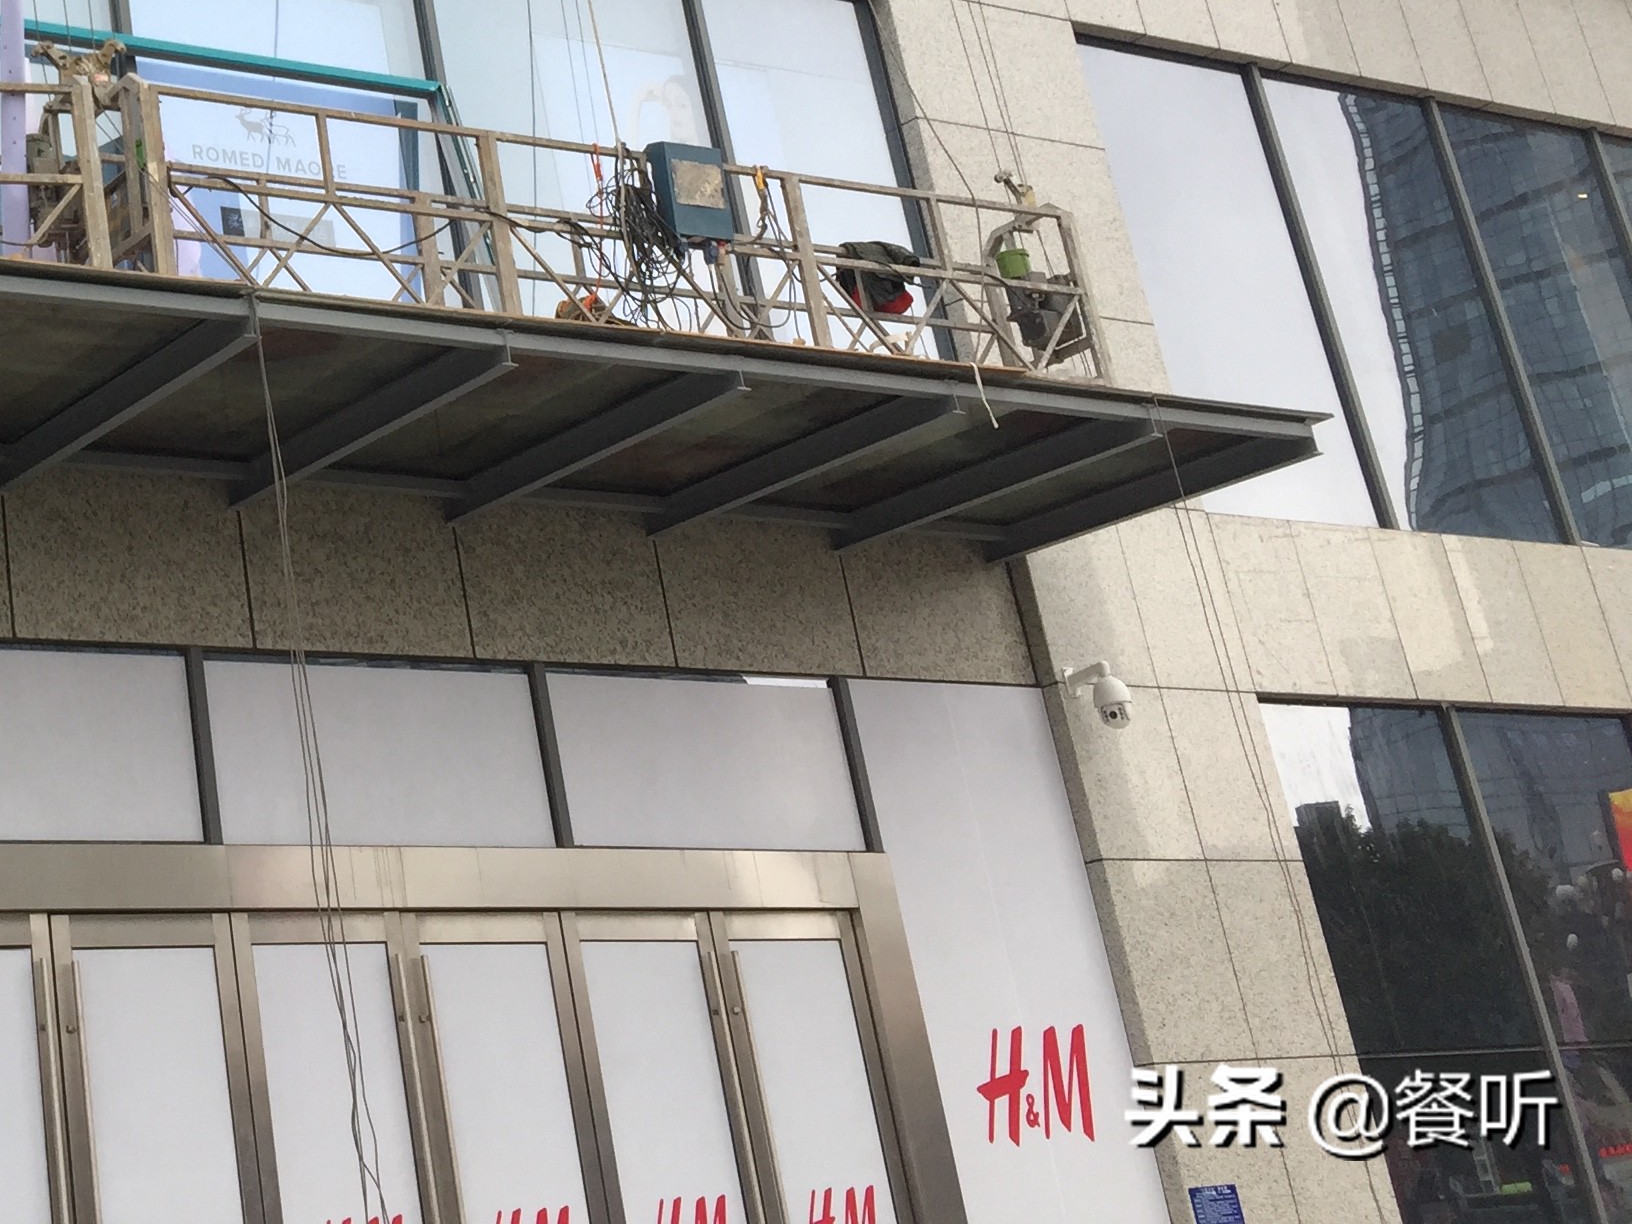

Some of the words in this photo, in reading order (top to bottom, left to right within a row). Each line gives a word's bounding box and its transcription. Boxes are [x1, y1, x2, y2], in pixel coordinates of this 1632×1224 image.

[191, 143, 265, 169] ROMED
[275, 155, 348, 180] MAOE
[976, 1023, 1096, 1147] H&M
